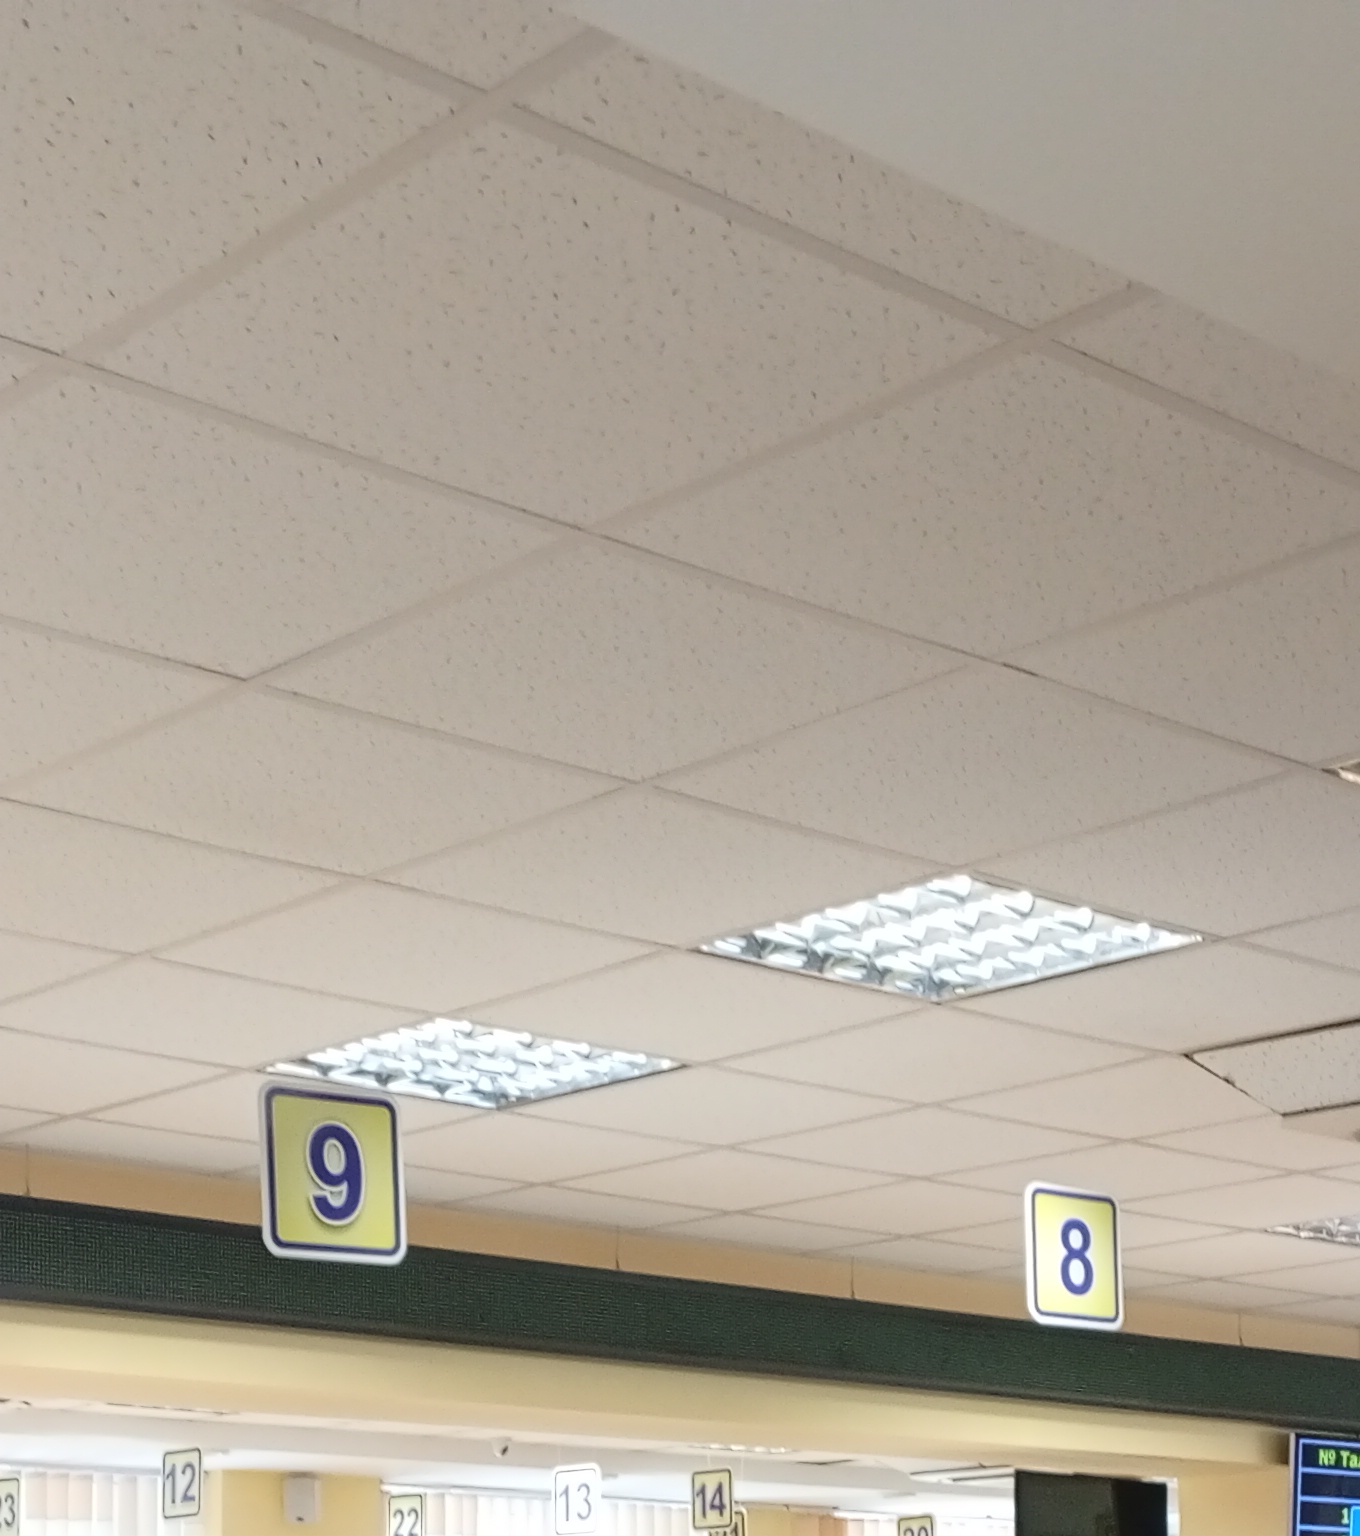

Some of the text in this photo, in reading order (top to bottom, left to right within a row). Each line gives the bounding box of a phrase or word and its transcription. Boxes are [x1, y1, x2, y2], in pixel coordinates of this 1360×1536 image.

[307, 1121, 364, 1225] 9
[1061, 1218, 1094, 1296] 8
[165, 1461, 196, 1505] 12
[559, 1482, 592, 1523] 13
[695, 1481, 727, 1519] 14
